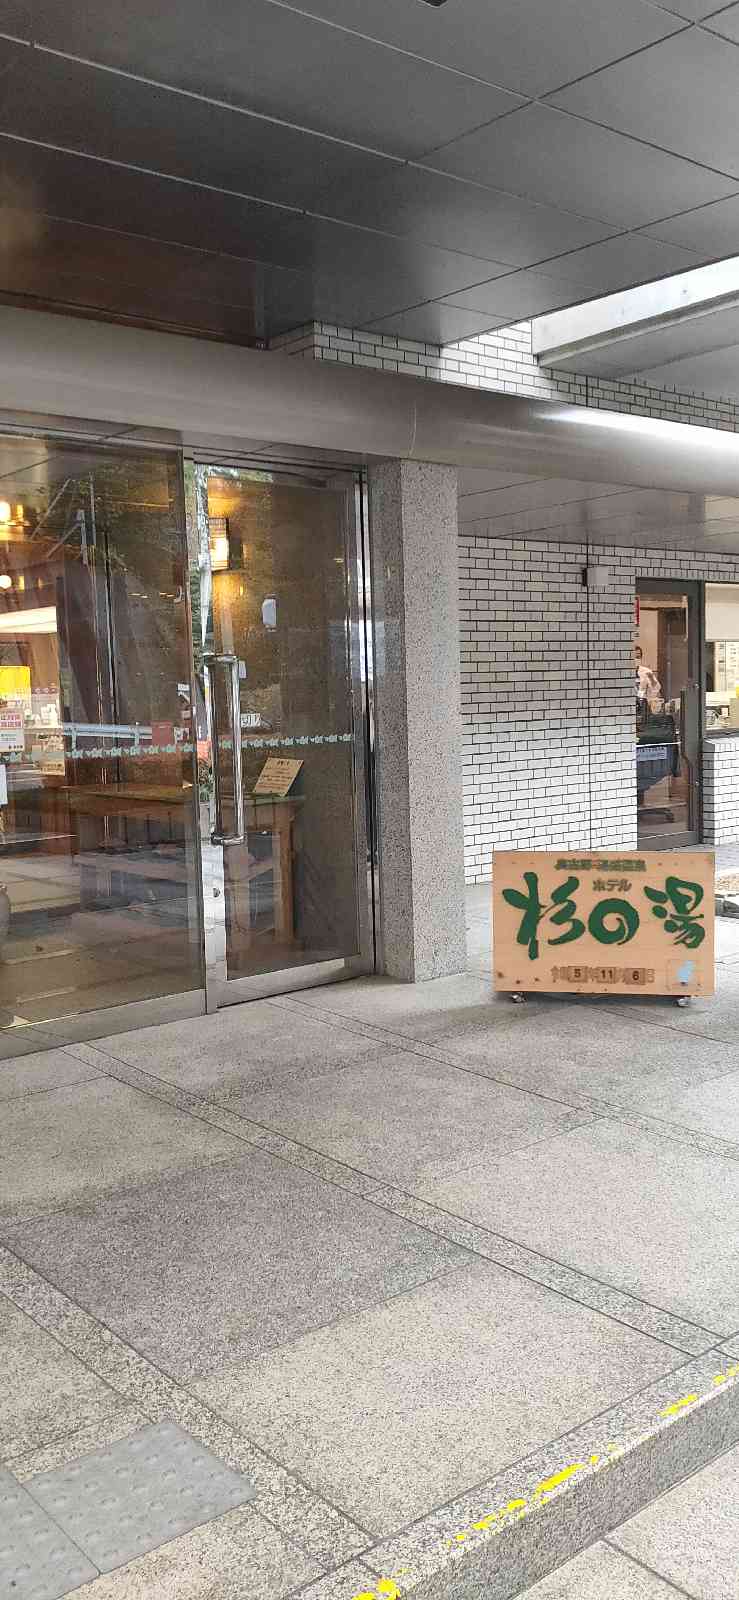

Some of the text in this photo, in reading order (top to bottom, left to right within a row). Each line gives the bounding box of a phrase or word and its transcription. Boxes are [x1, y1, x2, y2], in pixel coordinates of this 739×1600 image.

[592, 878, 632, 892] ホテル
[502, 871, 705, 960] 杉の湯
